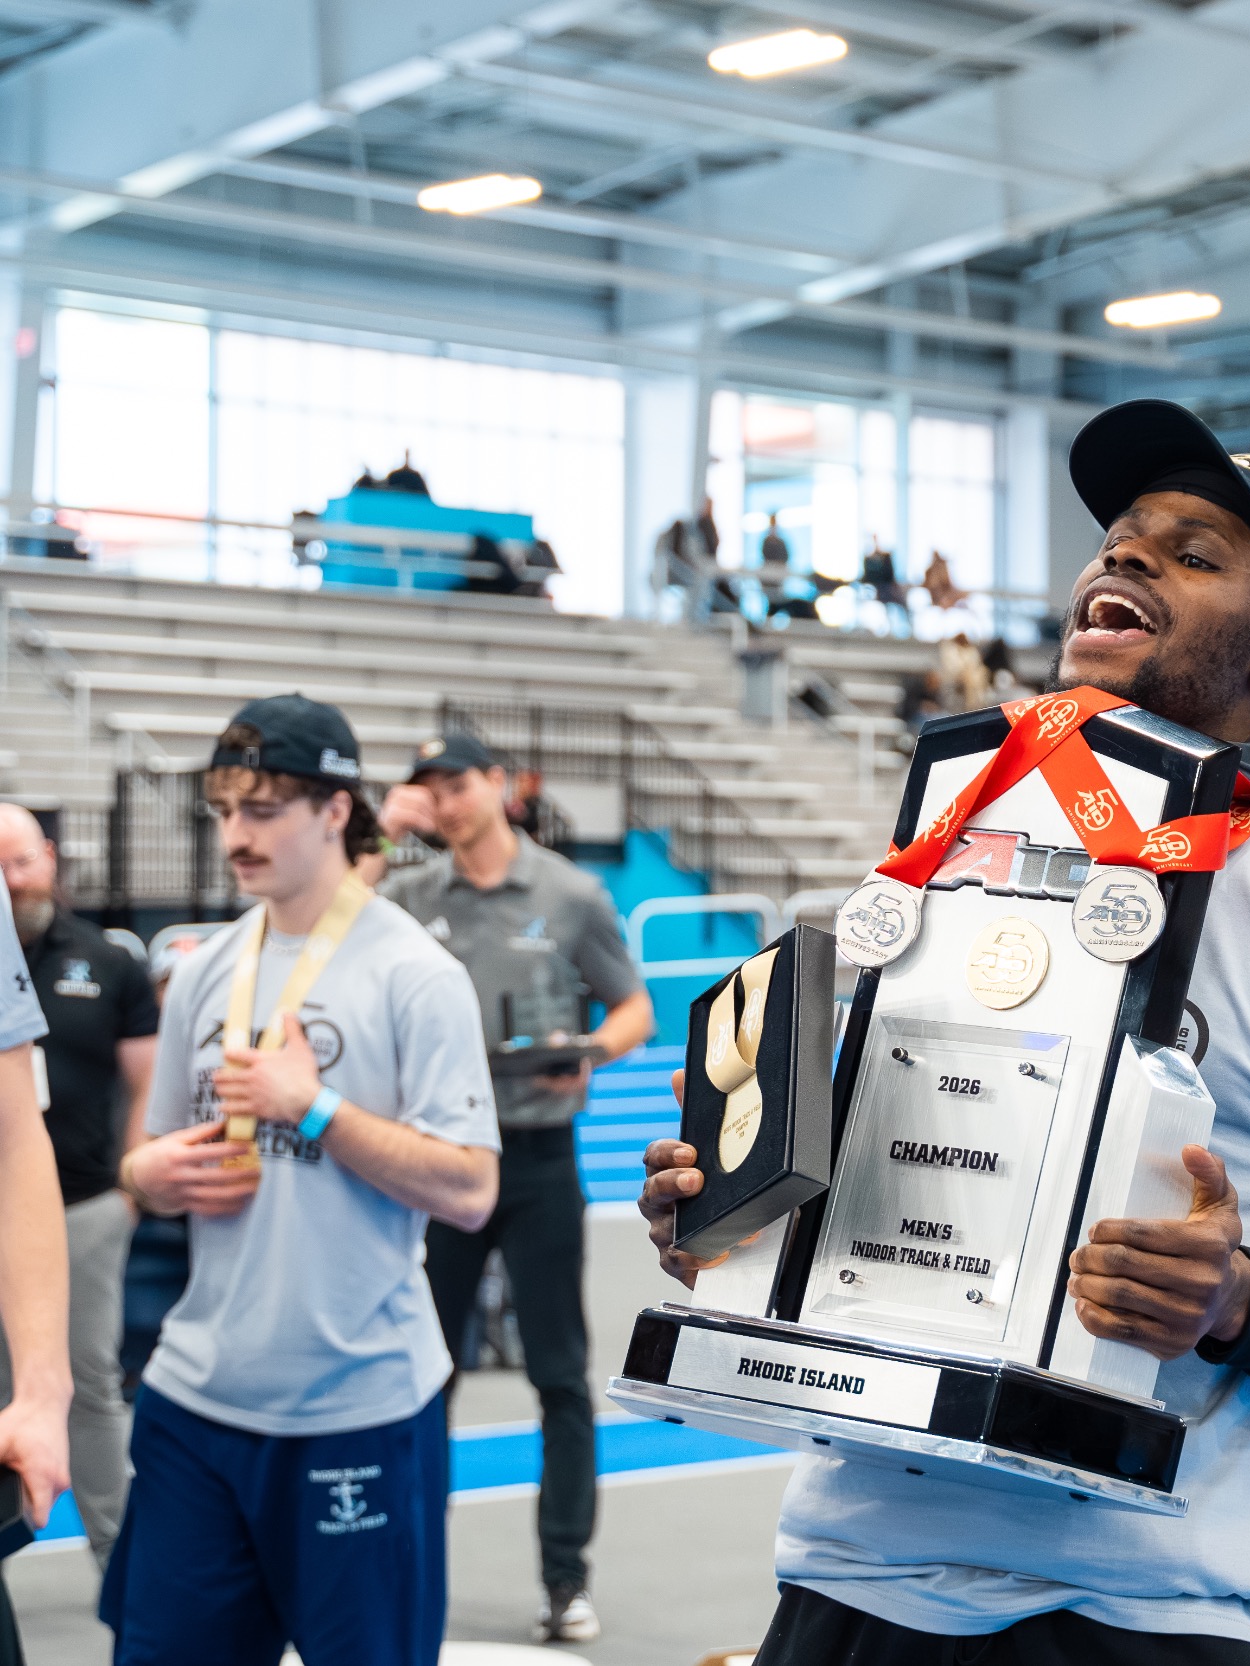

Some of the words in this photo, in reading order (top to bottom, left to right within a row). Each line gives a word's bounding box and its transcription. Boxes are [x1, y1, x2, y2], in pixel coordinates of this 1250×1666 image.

[1050, 716, 1084, 747] ANNIVERSARY
[941, 808, 966, 847] ANNIVERSARY
[1065, 806, 1086, 838] ANNIVERSARY
[938, 1075, 981, 1095] 2026
[889, 1140, 999, 1172] CHAMPION
[899, 1218, 953, 1240] MEN'S
[850, 1240, 897, 1261] INDOOR
[899, 1247, 941, 1268] TRACK
[942, 1254, 951, 1269] &
[953, 1255, 991, 1275] FIELD
[737, 1357, 797, 1383] RHODE
[798, 1367, 866, 1395] ISLAND
